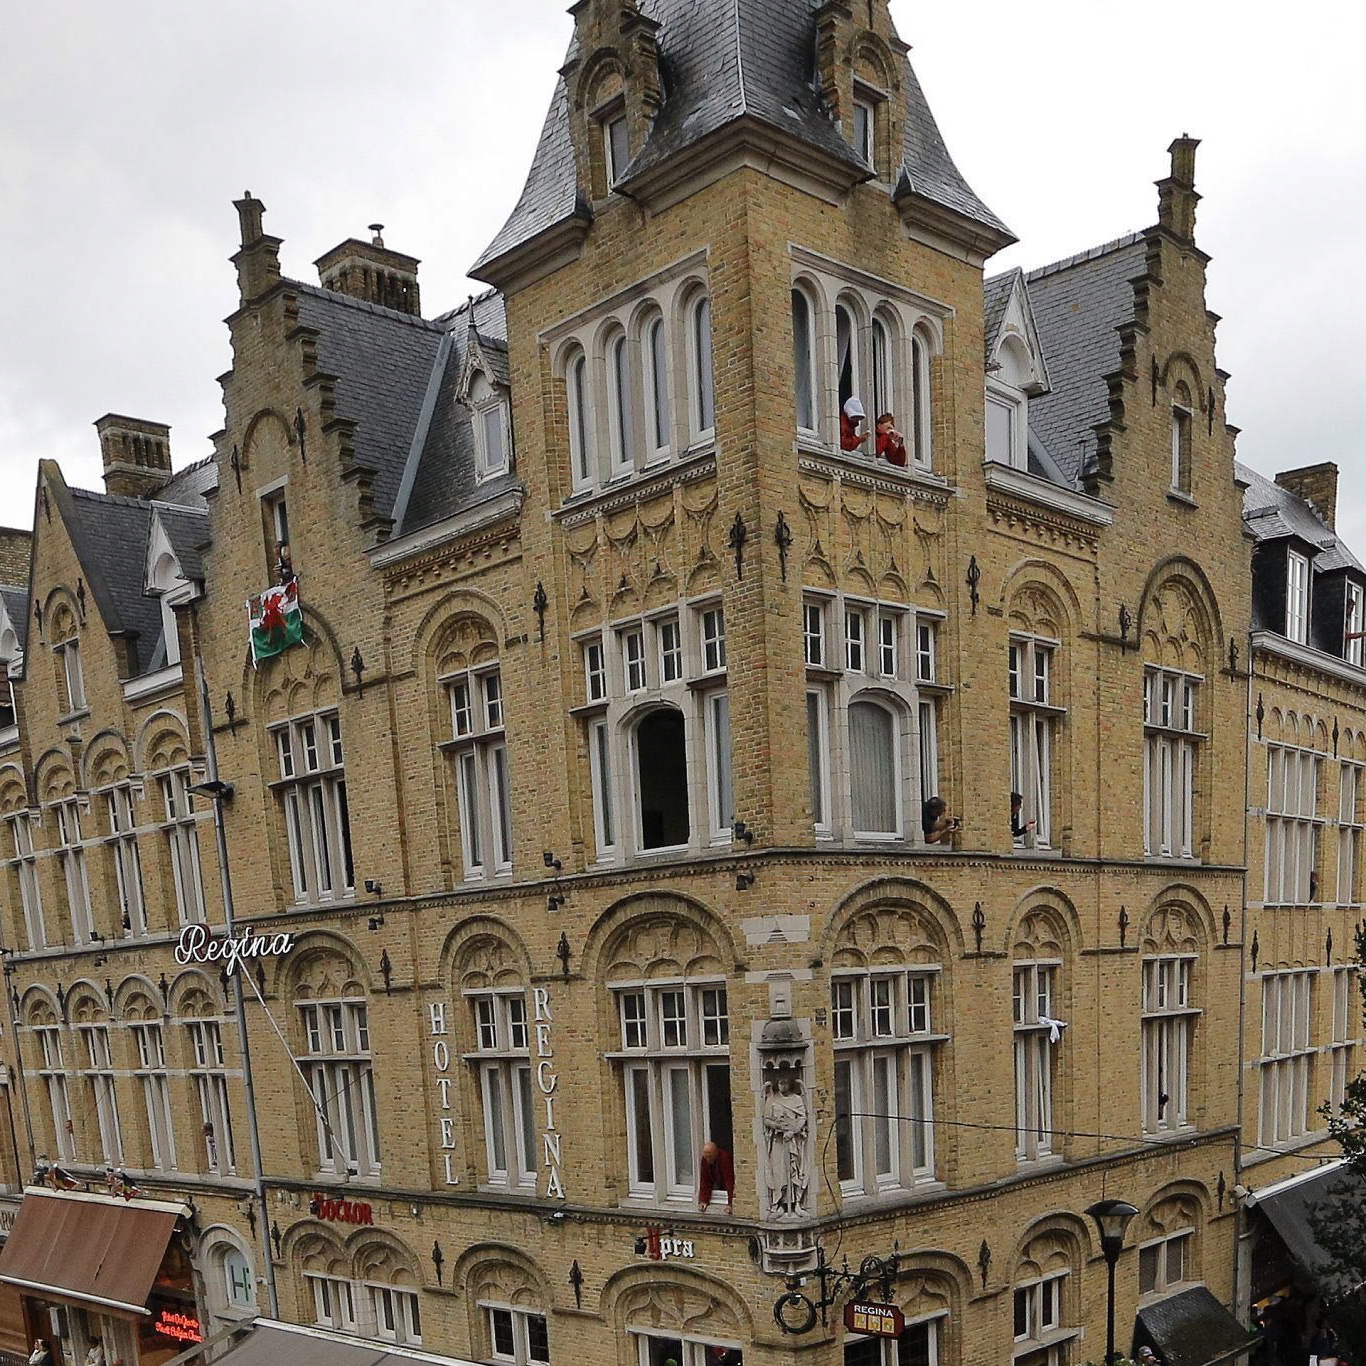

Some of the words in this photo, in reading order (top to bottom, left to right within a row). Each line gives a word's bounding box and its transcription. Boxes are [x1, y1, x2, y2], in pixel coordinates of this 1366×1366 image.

[174, 924, 295, 976] Regina
[428, 1003, 460, 1186] HOTEL
[533, 987, 566, 1199] REGINA
[853, 1304, 894, 1318] REGINA
